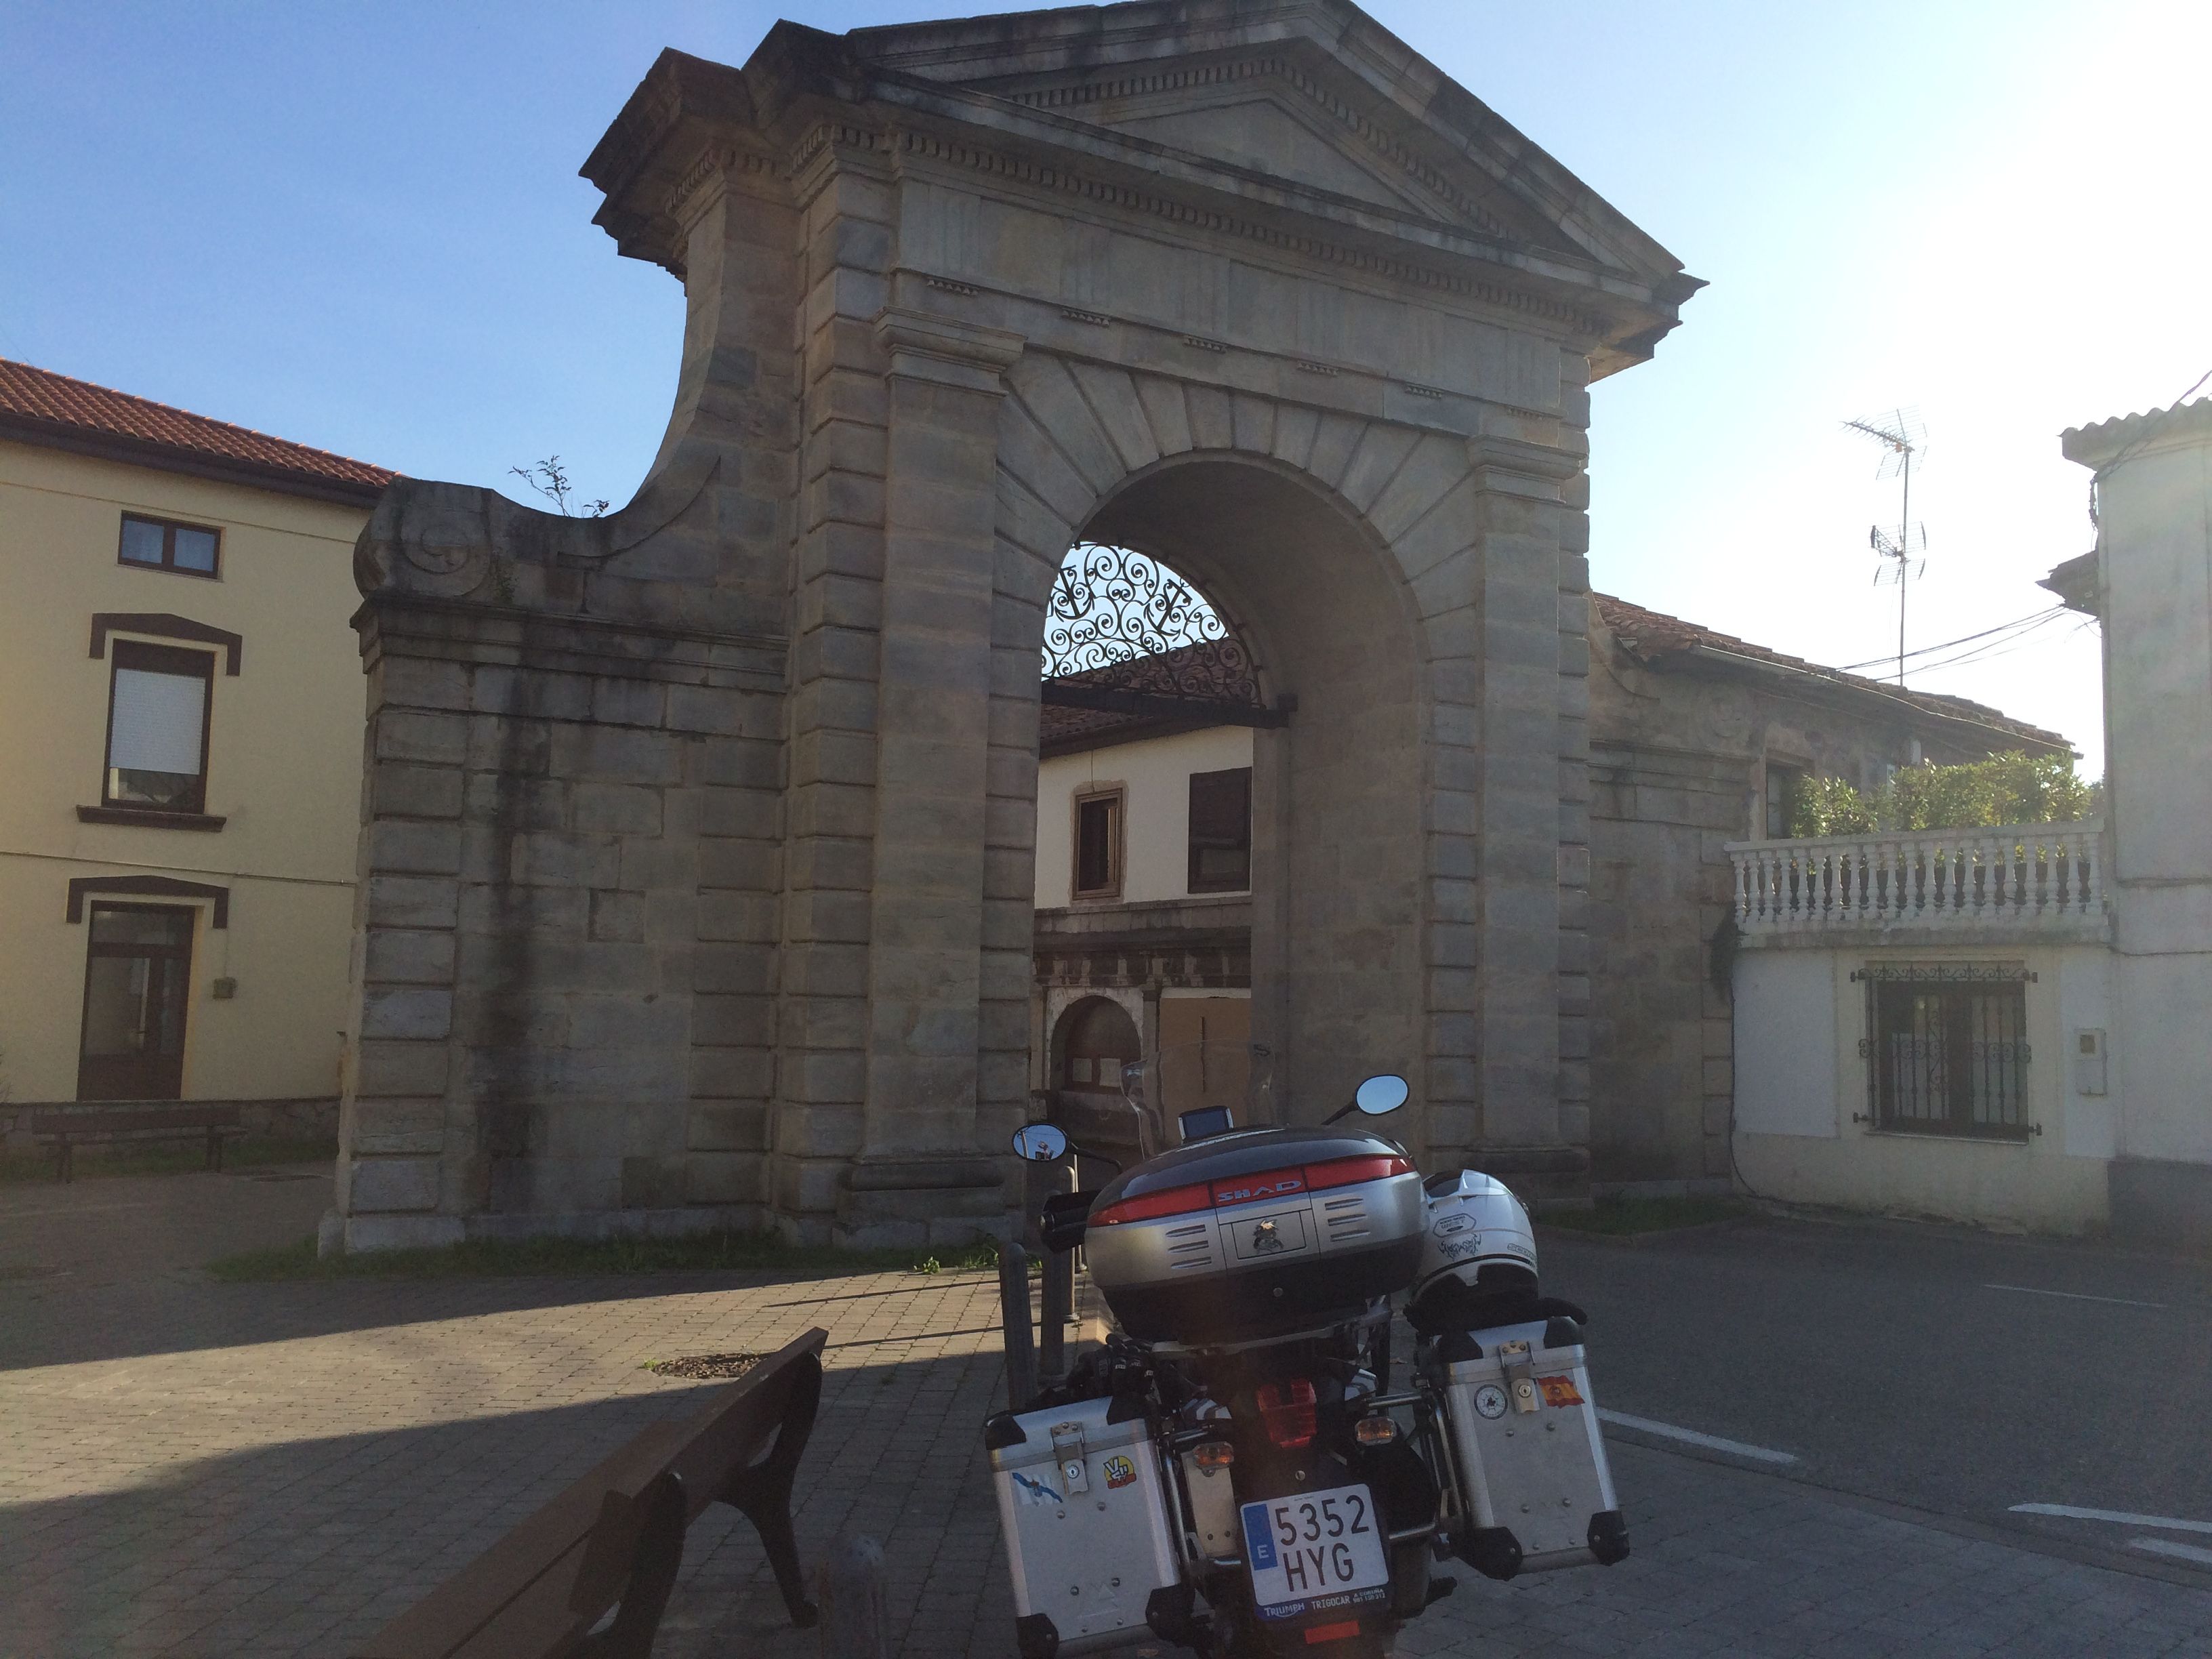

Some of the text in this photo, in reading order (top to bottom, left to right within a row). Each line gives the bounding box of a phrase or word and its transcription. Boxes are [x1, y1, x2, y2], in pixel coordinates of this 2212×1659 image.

[1218, 1180, 1302, 1202] SHAD
[1275, 1495, 1370, 1546] 5352
[1257, 1544, 1269, 1559] E
[1283, 1542, 1355, 1592] HYG
[1263, 1595, 1351, 1618] TRIUMPH TRIGOCAR
